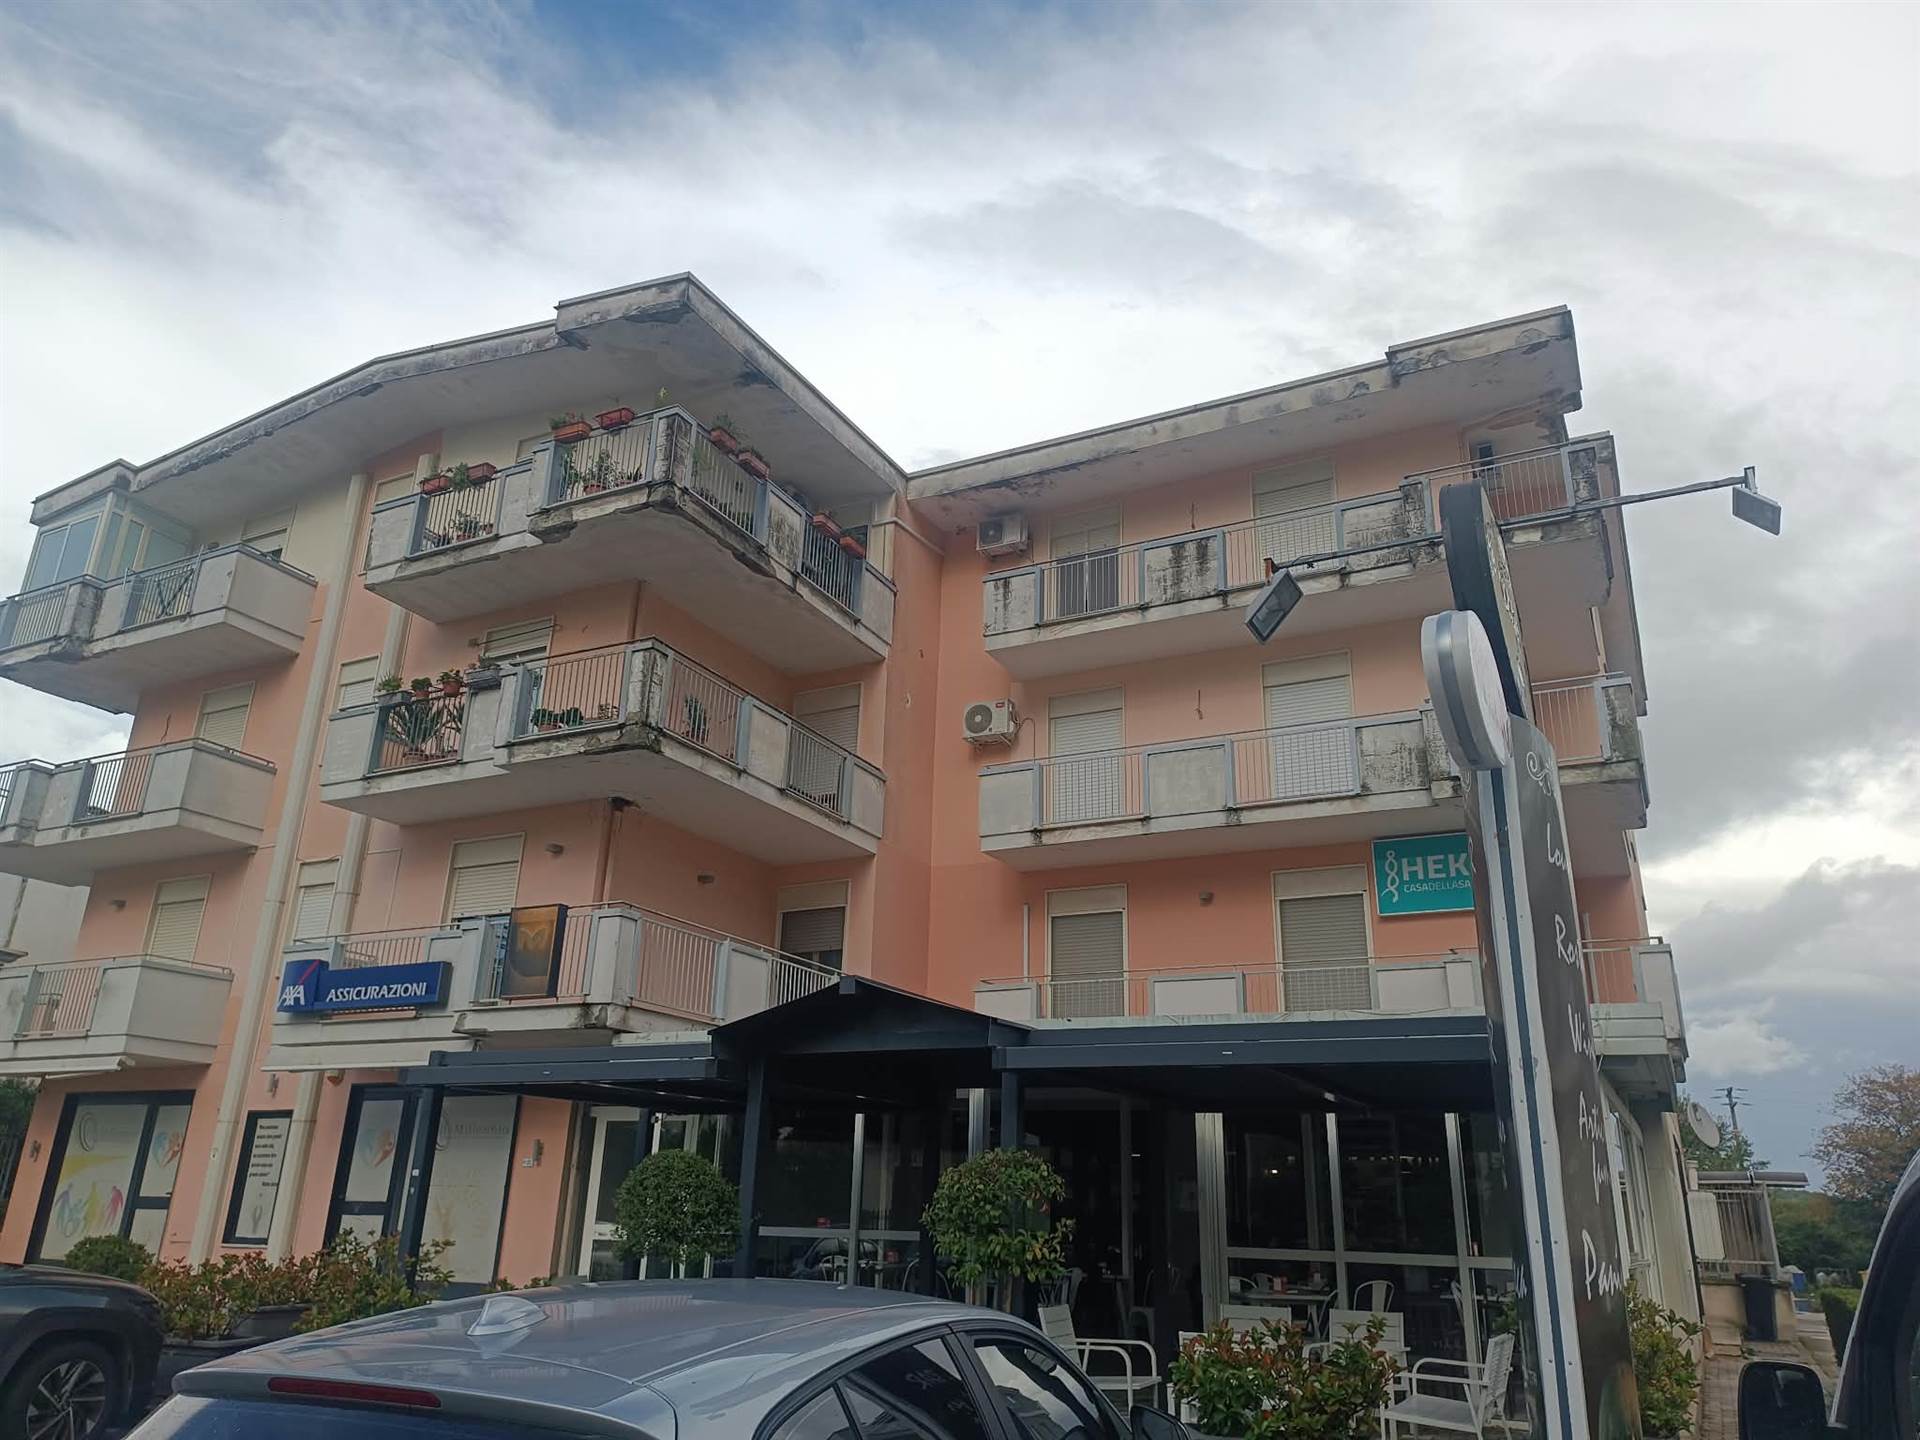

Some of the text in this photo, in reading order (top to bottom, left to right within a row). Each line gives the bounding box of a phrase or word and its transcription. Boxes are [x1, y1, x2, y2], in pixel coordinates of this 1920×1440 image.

[1401, 852, 1470, 880] HEK
[1404, 880, 1472, 893] CASADELLASA
[278, 984, 305, 1006] AXA
[326, 982, 427, 1002] ASSICURAZIONI
